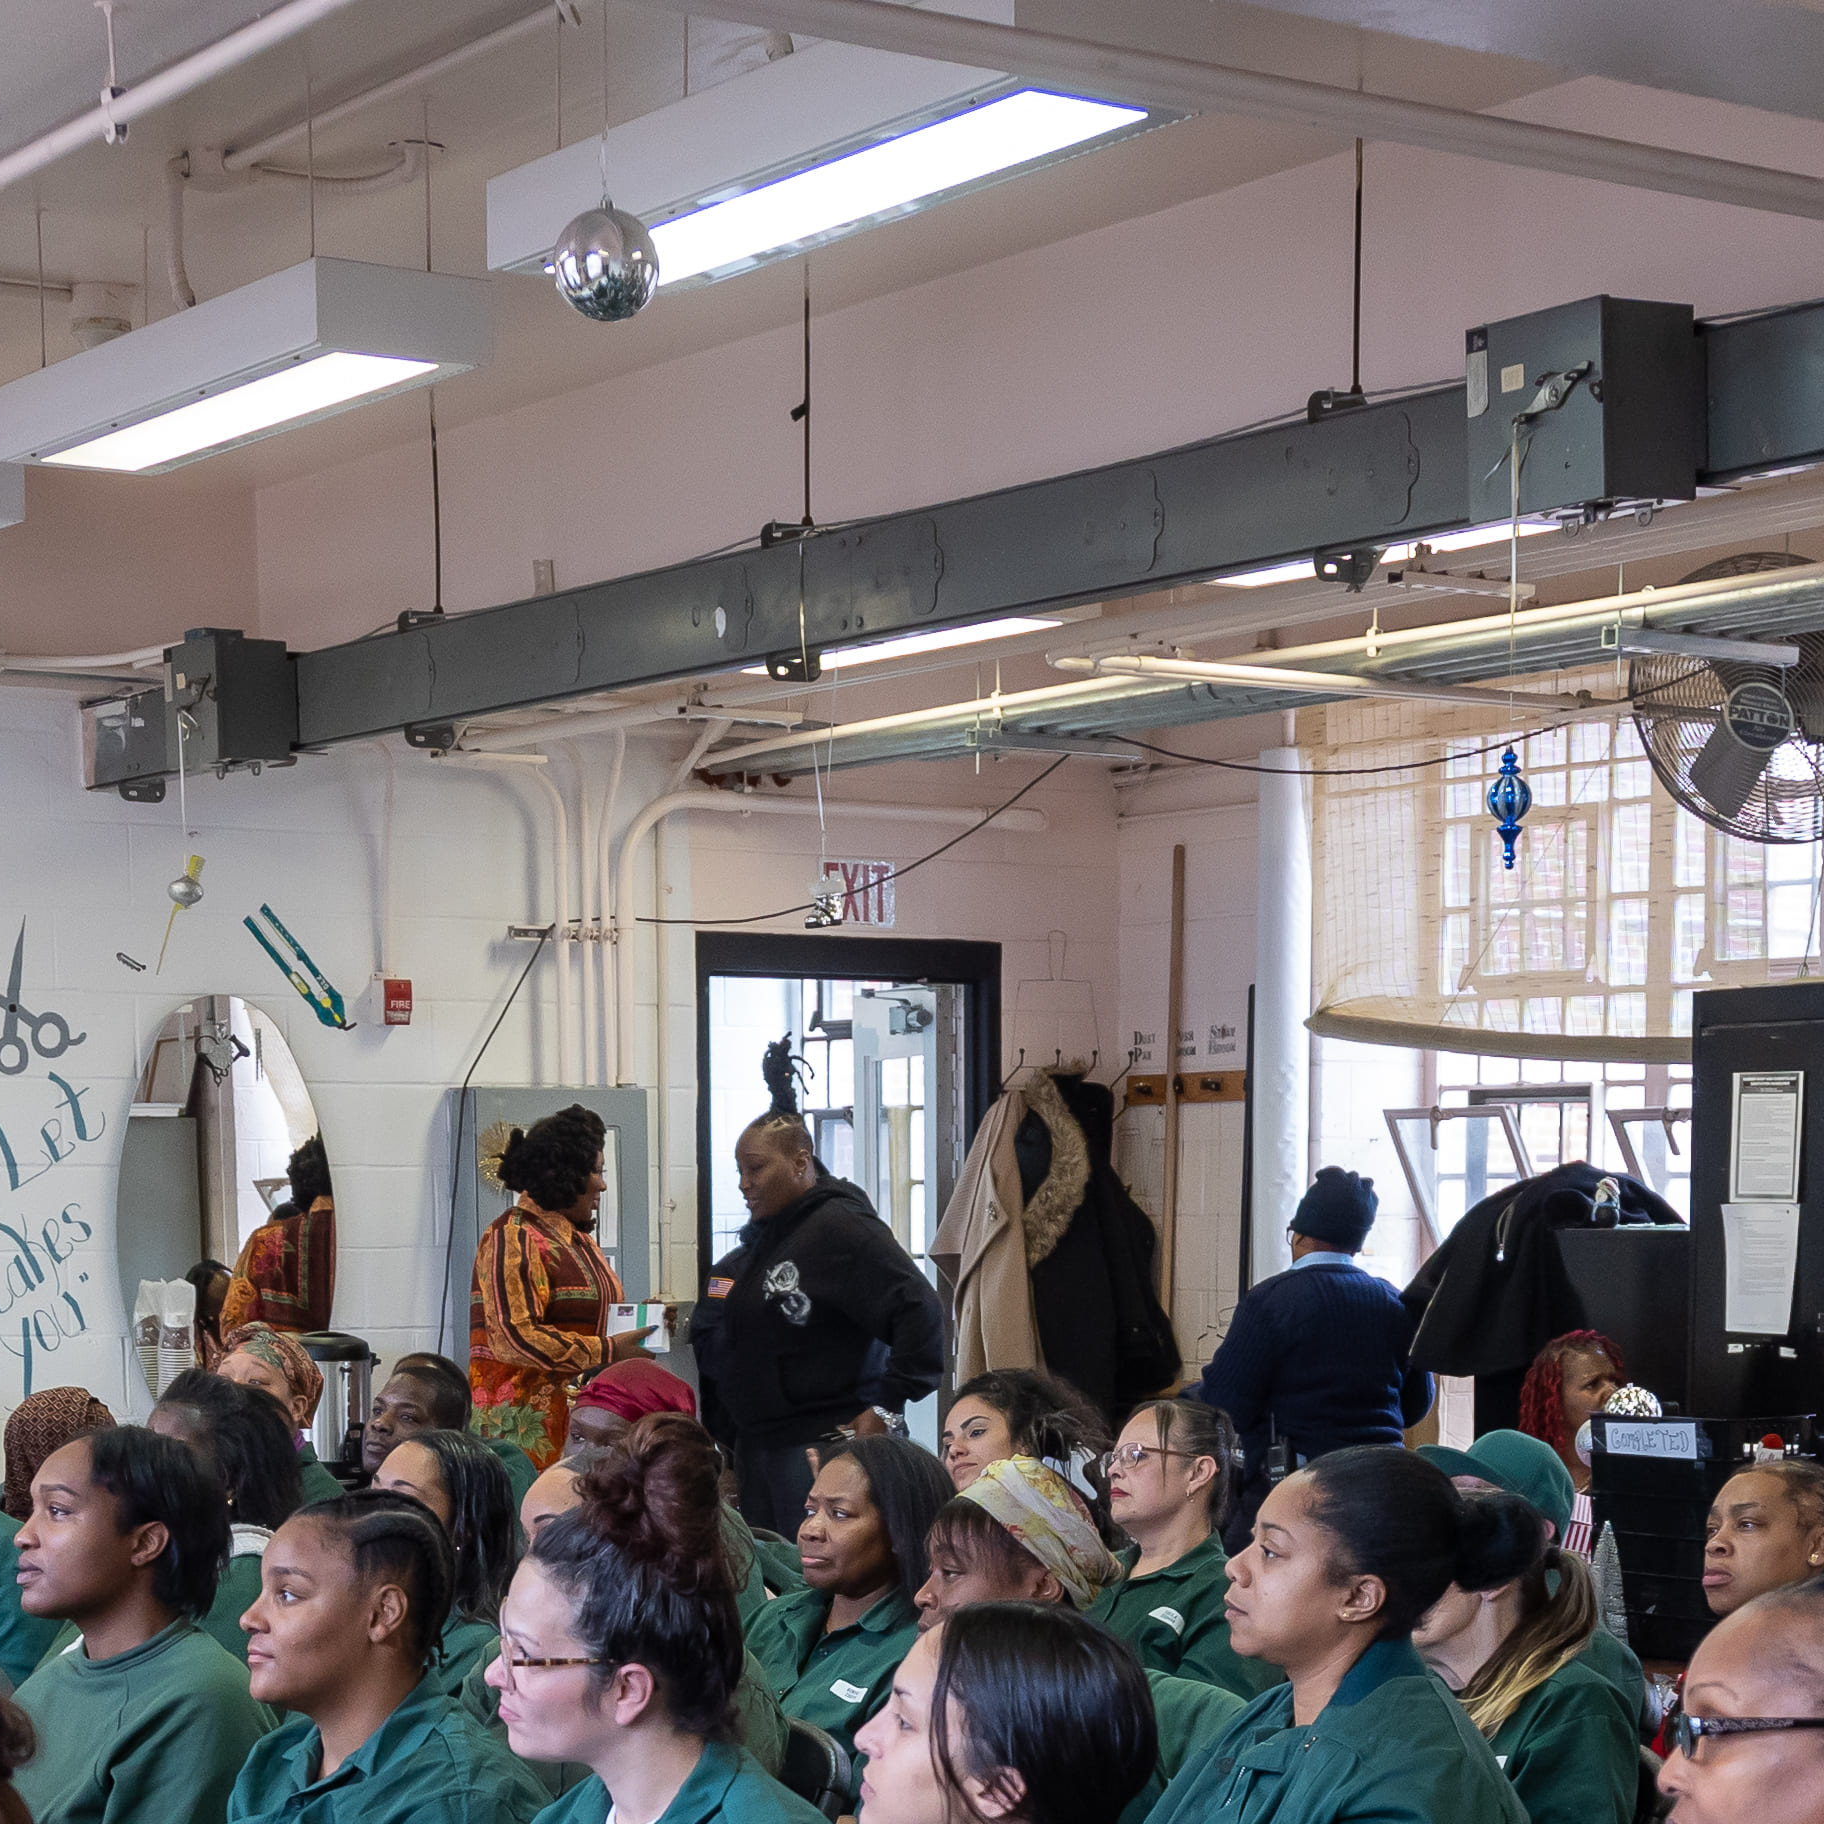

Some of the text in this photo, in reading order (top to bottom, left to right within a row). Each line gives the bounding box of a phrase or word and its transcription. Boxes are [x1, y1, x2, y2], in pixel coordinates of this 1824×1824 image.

[1729, 705, 1790, 728] PATTON
[390, 1000, 411, 1009] FIRE
[1611, 1427, 1689, 1452] COMPLETED
